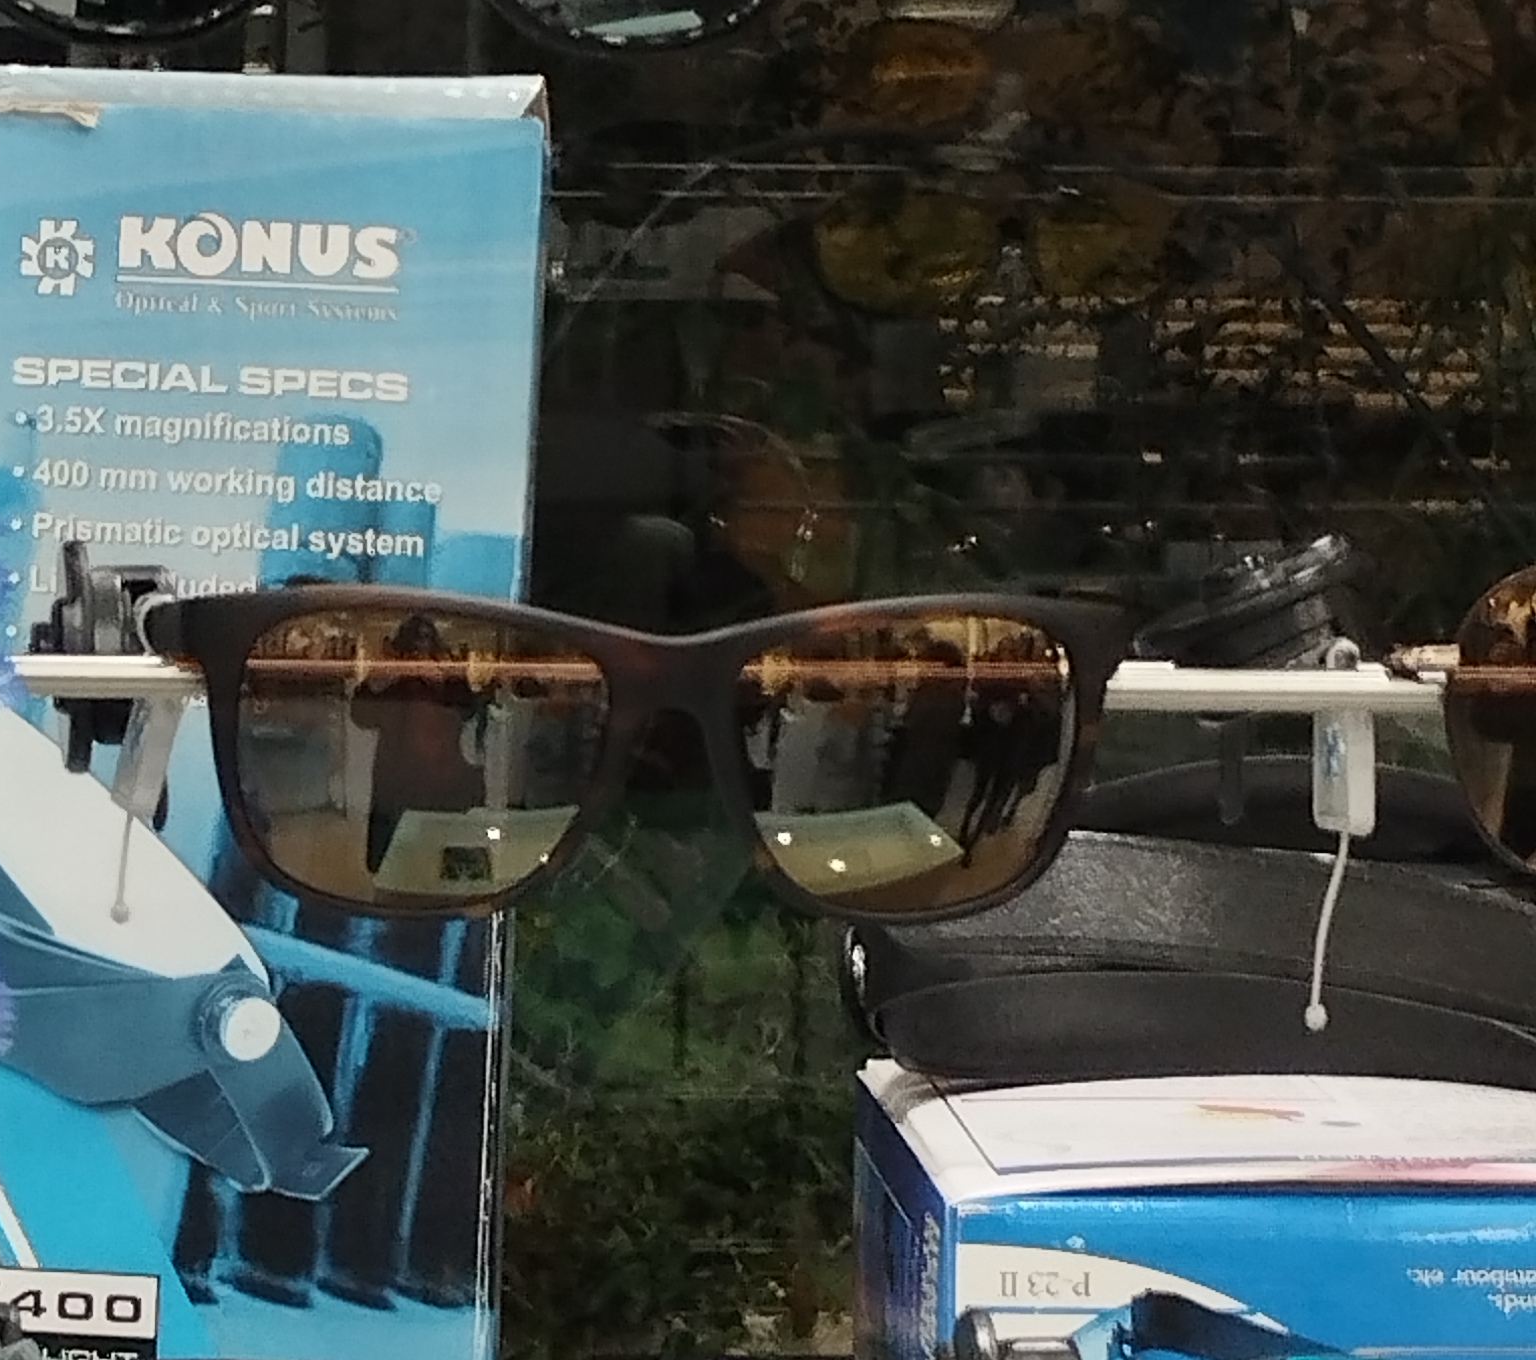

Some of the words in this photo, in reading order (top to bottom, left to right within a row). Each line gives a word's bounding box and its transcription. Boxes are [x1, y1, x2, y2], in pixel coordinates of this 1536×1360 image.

[118, 212, 401, 280] KONUS
[12, 356, 228, 394] SPECIAL
[239, 366, 409, 401] SPECS
[114, 411, 351, 446] magnifications
[32, 458, 91, 488] 400
[99, 465, 158, 492] mm
[167, 467, 296, 501] working
[306, 472, 443, 506] distance
[31, 512, 184, 547] Prismatic
[191, 522, 299, 554] optical
[308, 529, 425, 562] system
